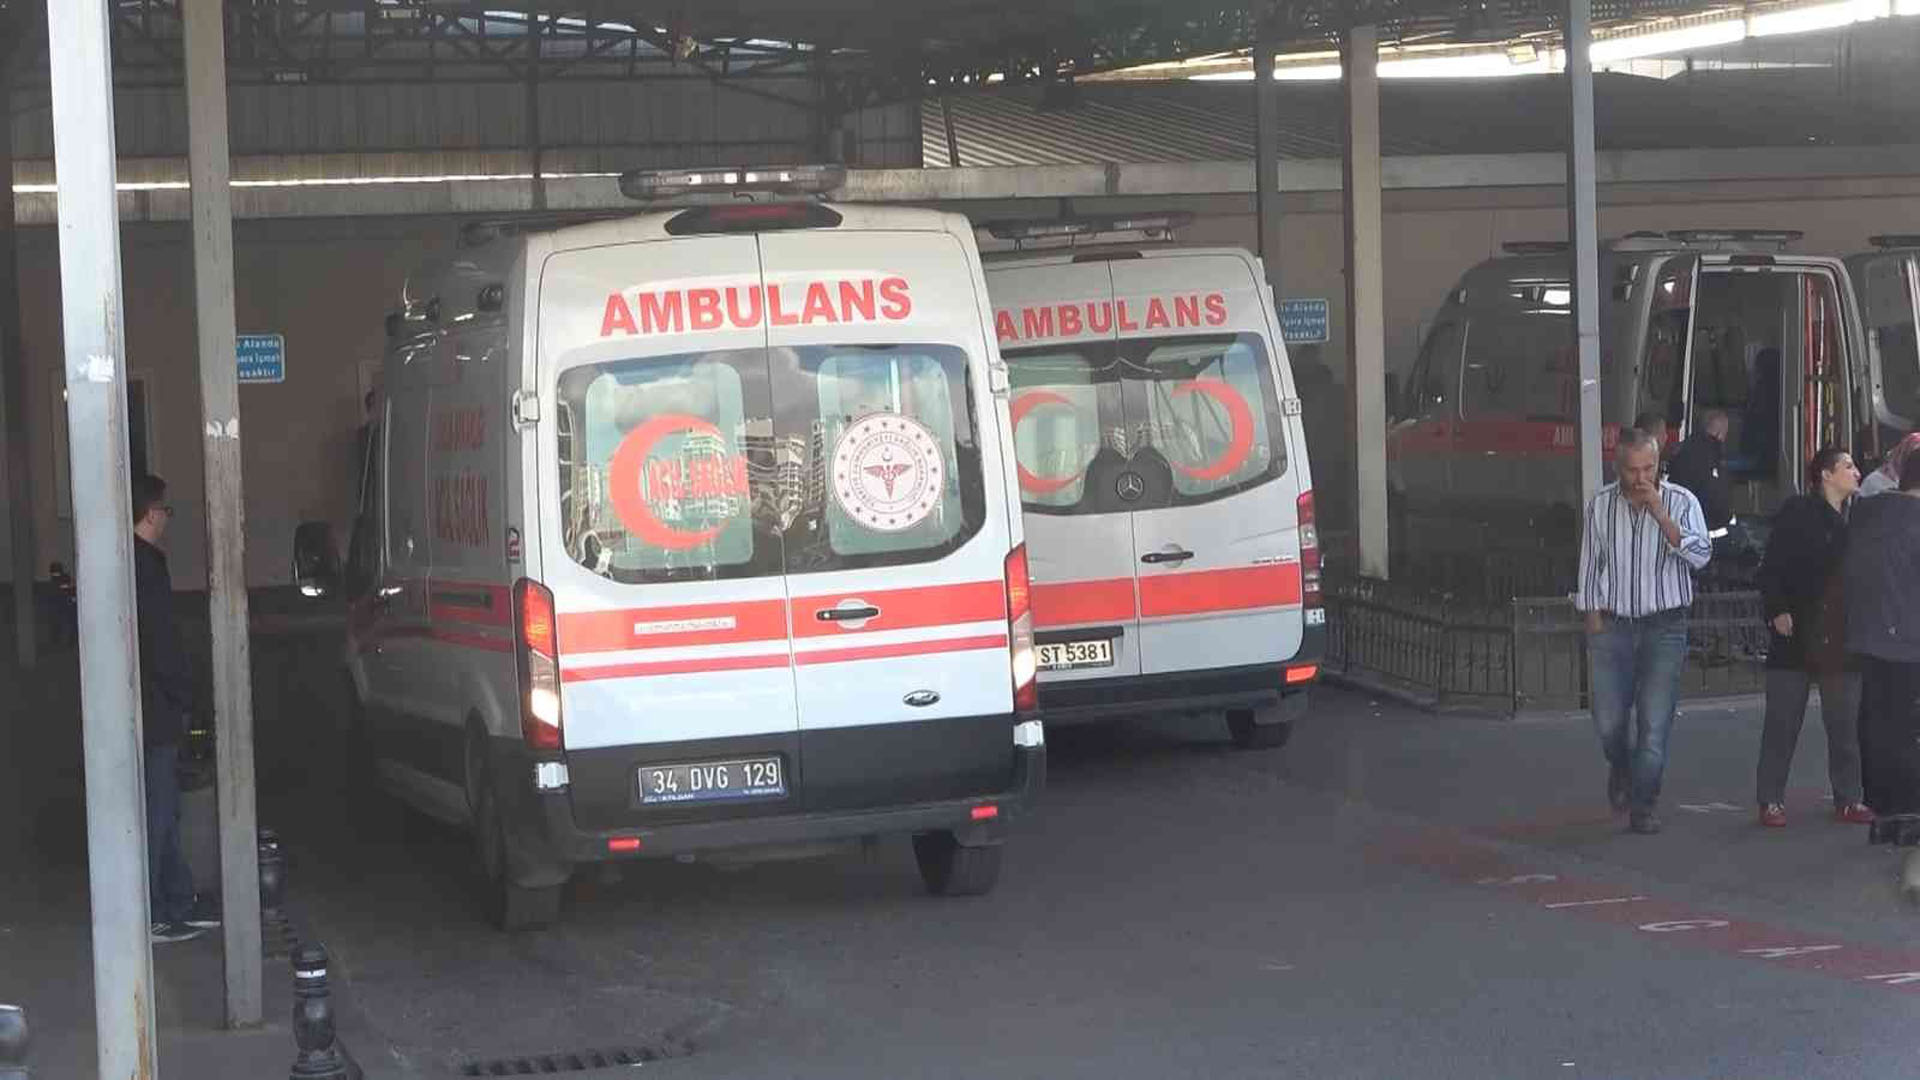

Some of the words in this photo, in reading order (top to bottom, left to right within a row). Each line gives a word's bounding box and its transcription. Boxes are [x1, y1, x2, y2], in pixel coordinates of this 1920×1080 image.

[600, 277, 912, 336] AMBULANS
[995, 293, 1227, 341] AMBULANS
[1041, 646, 1060, 663] ST
[1065, 643, 1107, 661] 5381
[653, 770, 678, 794] 34
[690, 765, 729, 791] DVG
[743, 762, 778, 786] 129
